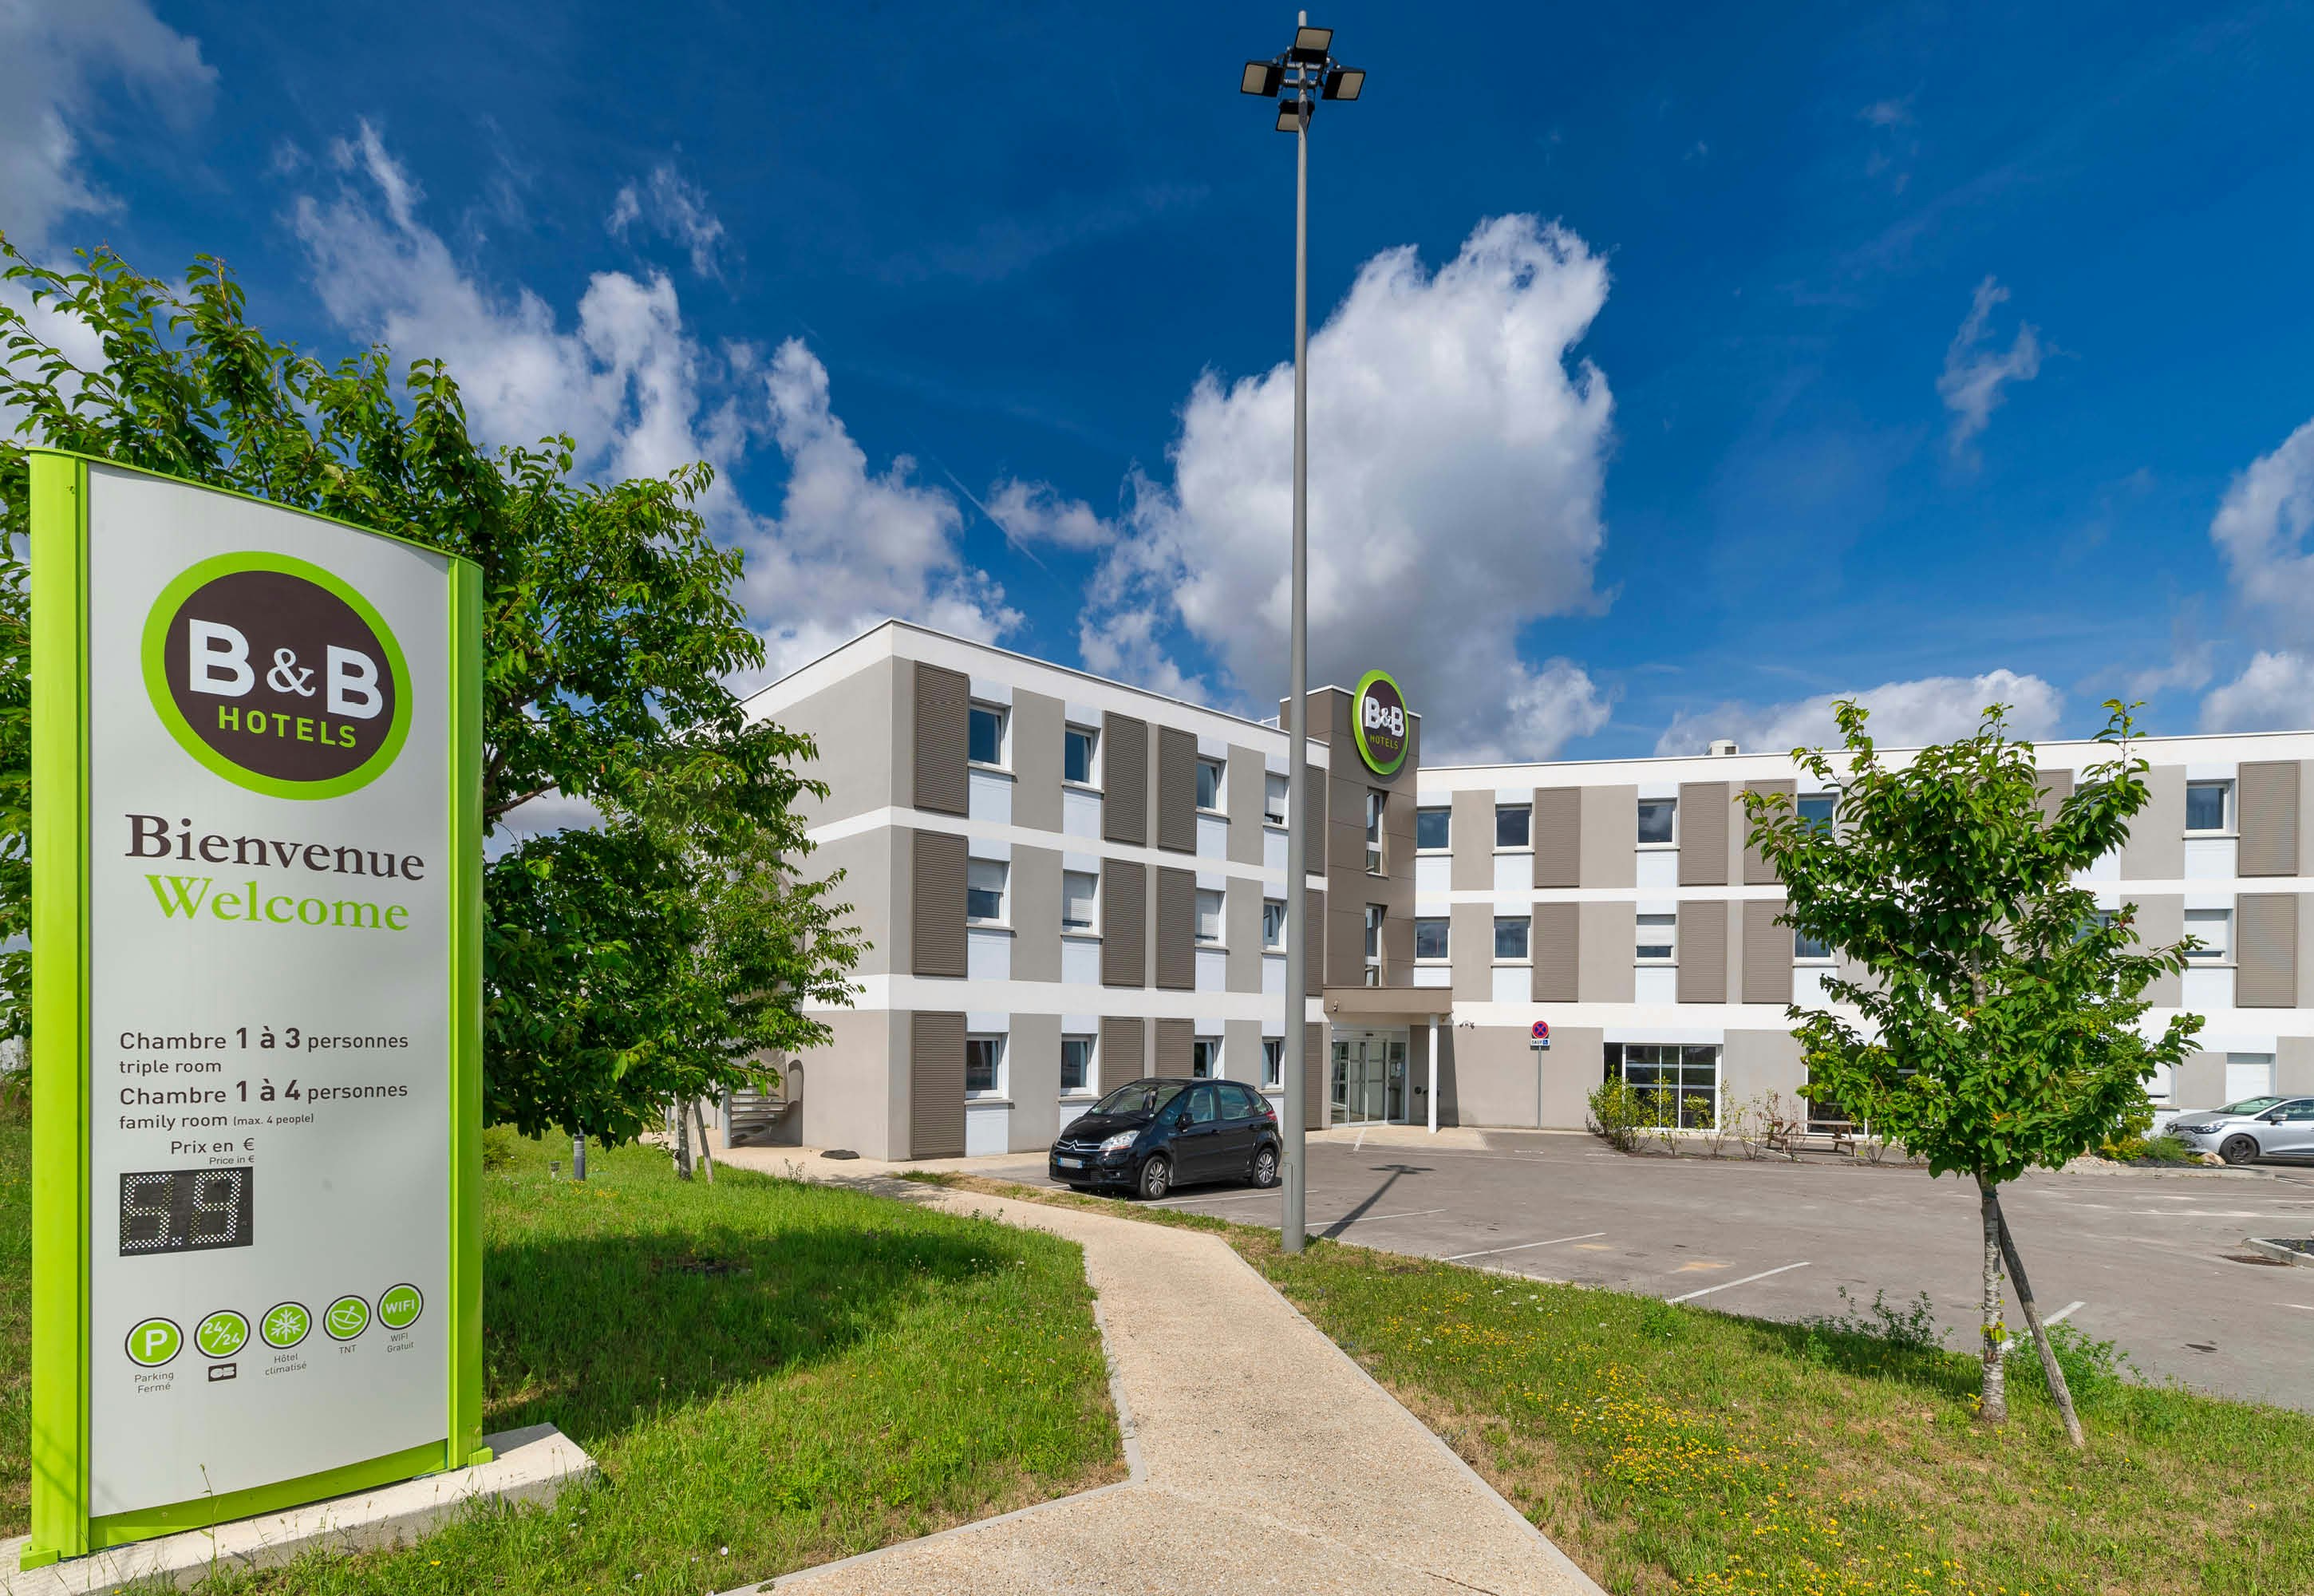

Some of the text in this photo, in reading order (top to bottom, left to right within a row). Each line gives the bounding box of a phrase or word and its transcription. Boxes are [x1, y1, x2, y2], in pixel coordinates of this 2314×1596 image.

[218, 705, 357, 749] HOTELS
[1370, 734, 1399, 750] HOTELS
[124, 814, 424, 881] Bienvenue
[144, 875, 409, 931] Welcome
[120, 1025, 409, 1053] Chambre 1 à 3 personnes
[120, 1060, 222, 1077] triple room
[120, 1079, 409, 1105] Chambre 1 à 4 personnes
[120, 1115, 176, 1132] family
[182, 1116, 227, 1128] room
[267, 1116, 273, 1124] 4
[171, 1138, 255, 1155] Prix en €
[209, 1156, 235, 1165] Price
[248, 1155, 255, 1163] €
[385, 1298, 416, 1315] WIFI
[145, 1329, 168, 1357] P
[390, 1333, 409, 1342] WIFI
[339, 1345, 357, 1354] TNT
[387, 1341, 415, 1353] Gratuit
[274, 1353, 298, 1364] Hôtel
[264, 1360, 308, 1376] climatisé
[134, 1372, 175, 1384] Parking
[137, 1382, 172, 1394] Fermé
